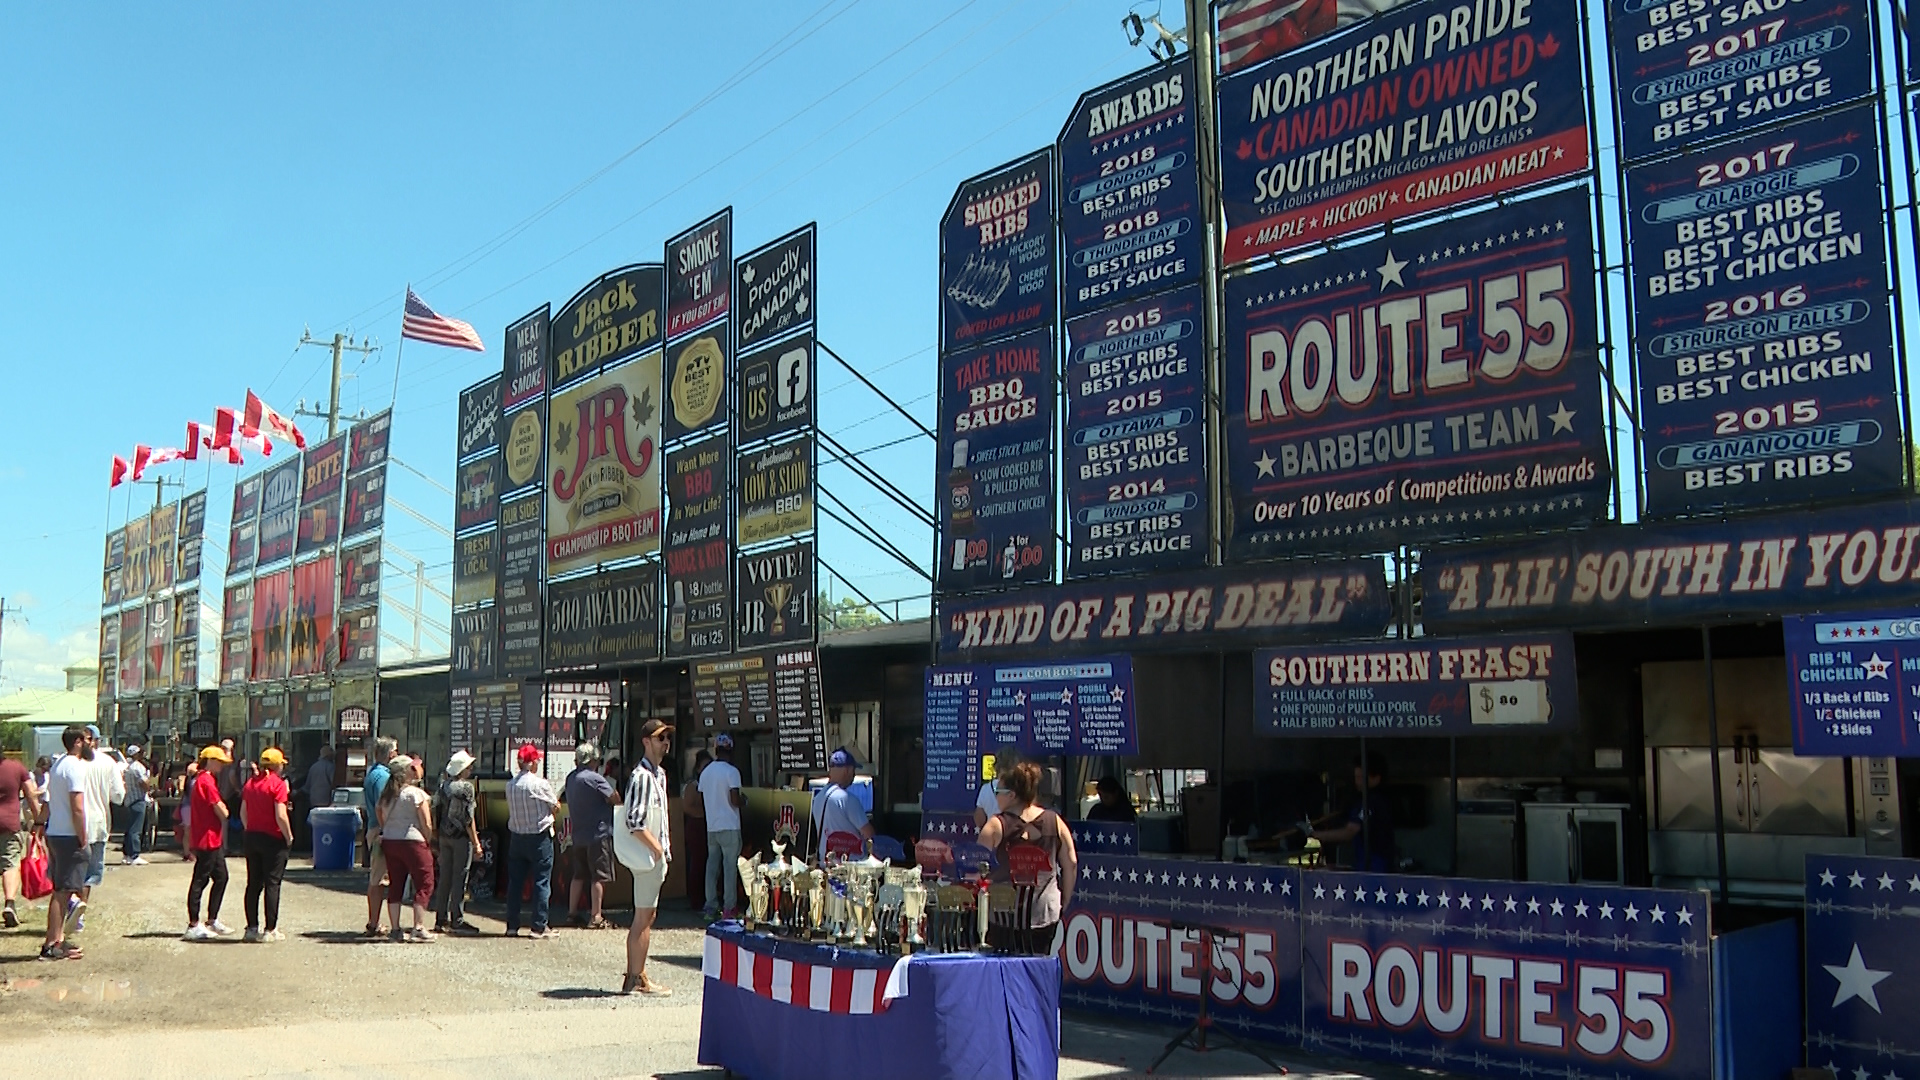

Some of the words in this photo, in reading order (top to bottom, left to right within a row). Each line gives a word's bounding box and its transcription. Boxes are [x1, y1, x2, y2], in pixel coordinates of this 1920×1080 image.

[1637, 13, 1712, 52] BEST
[1686, 20, 1786, 67] 2017
[1249, 22, 1416, 123] NORTHERN
[1425, 0, 1531, 67] PRIDE
[1654, 56, 1761, 96] STRURGEON
[1770, 34, 1826, 63] FALLS
[1088, 74, 1184, 137] AWARDS
[1255, 76, 1401, 161] CANADIAN
[1408, 34, 1535, 108] OWNED
[1660, 83, 1736, 119] BEST
[1746, 58, 1822, 88] RIBS
[1653, 108, 1729, 142] BEST
[1736, 78, 1832, 119] SAUCE
[1253, 126, 1394, 203] SOUTHERN
[1402, 81, 1538, 157] FLAVORS
[1096, 164, 1156, 191] LONDON
[1100, 146, 1156, 177] 2018
[1283, 191, 1313, 211] LOUIS
[1320, 175, 1370, 199] MEMPHIS
[1377, 155, 1428, 181] CHICAGO
[1437, 145, 1467, 164] NEW
[1469, 129, 1525, 156] ORLEANS
[1696, 142, 1796, 187] 2017
[964, 180, 1041, 227] SMOKED
[1083, 190, 1126, 215] BEST
[1130, 174, 1171, 198] RIBS
[1255, 218, 1306, 246] MAPLE
[1322, 191, 1390, 228] HICKORY
[1404, 160, 1496, 203] CANADIAN
[1500, 147, 1551, 177] MEAT
[1696, 173, 1798, 210] CALABOGIE
[980, 209, 1028, 245] RIBS
[1104, 212, 1159, 240] 2018
[1676, 209, 1748, 243] BEST
[1755, 190, 1824, 226] RIBS
[679, 229, 719, 275] SMOKE
[1009, 234, 1046, 257] HICKORY
[1018, 247, 1045, 264] WOOD
[1664, 238, 1734, 270] BEST
[1742, 211, 1842, 253] SAUCE
[749, 246, 799, 309] Proudly
[1018, 265, 1049, 284] CHERRY
[1079, 280, 1122, 302] BEST
[1126, 259, 1185, 289] SAUCE
[1649, 266, 1718, 297] BEST
[1725, 232, 1863, 280] CHICKEN
[743, 262, 809, 340] CANADIAN
[1018, 280, 1044, 295] WOOD
[1704, 285, 1807, 322] 2016
[573, 279, 637, 339] Jack
[1106, 308, 1161, 336] 2015
[517, 322, 539, 349] MEAT
[557, 309, 657, 381] RIBBER
[1246, 283, 1471, 424] ROUTE
[1479, 262, 1570, 380] 55
[1670, 317, 1779, 350] STRURGEON
[1788, 306, 1844, 330] FALLS
[520, 346, 538, 372] FIRE
[955, 354, 990, 392] TAKE
[995, 347, 1040, 375] HOME
[511, 368, 542, 397] SMOKE
[748, 372, 768, 388] FOLLOW
[970, 378, 1023, 407] BBQ
[1656, 376, 1732, 404] BEST
[1740, 352, 1872, 390] CHICKEN
[749, 388, 767, 420] US
[777, 404, 807, 422] facebook
[956, 397, 1036, 432] SAUCE
[1107, 390, 1163, 415] 2015
[1715, 400, 1819, 434] 2015
[1087, 439, 1130, 461] BEST
[1135, 431, 1178, 452] RIBS
[1100, 416, 1164, 439] OTTAWA
[1282, 420, 1434, 477] BARBEQUE
[1445, 404, 1539, 452] TEAM
[1692, 428, 1840, 460] GANANOQUE
[306, 450, 342, 489] BITE
[685, 469, 712, 498] BBQ
[744, 471, 766, 504] LOW
[779, 460, 807, 494] SLOW
[980, 467, 999, 482] SLOW
[1000, 463, 1028, 478] COOKED
[1030, 459, 1043, 471] RIB
[991, 478, 1018, 494] PULLED
[1020, 474, 1040, 490] PORK
[1685, 462, 1765, 490] BEST
[1774, 451, 1853, 480] RIBS
[981, 500, 1016, 518] SOUTHERN
[1017, 495, 1046, 511] CHICKEN
[1109, 478, 1165, 502] 2014
[1254, 499, 1296, 523] Over
[1300, 494, 1321, 516] 10
[1325, 486, 1371, 512] Years
[1375, 481, 1394, 504] of
[1400, 470, 1511, 503] Competitions
[1531, 458, 1595, 487] Awards
[503, 507, 517, 524] OUR
[519, 500, 539, 518] SIDES
[1103, 500, 1167, 518] WINDSOR
[464, 536, 490, 556] FRESH
[554, 528, 609, 558] CHAMPIONSHIP
[612, 524, 631, 542] BBQ
[633, 516, 654, 536] TEAM
[1082, 543, 1126, 562] BEST
[1130, 535, 1191, 554] SAUCE
[464, 558, 488, 576] LOCAL
[747, 552, 804, 585] VOTE!
[1572, 544, 1729, 602] SOUTH
[1732, 538, 1796, 591] IN
[552, 596, 580, 634] 500
[582, 582, 654, 629] AWARDS!
[742, 600, 764, 635] JR
[790, 590, 809, 626] #1
[1050, 596, 1104, 642] OF
[1102, 596, 1134, 638] A
[1140, 587, 1214, 633] PIG
[777, 651, 813, 665] MENU
[1270, 652, 1430, 686] SOUTHERN
[1439, 645, 1552, 680] FEAST
[1800, 667, 1864, 682] CHICKEN
[933, 672, 972, 686] MENU
[1078, 684, 1106, 694] DOUBLE
[1281, 690, 1304, 701] FULL
[1308, 689, 1334, 700] RACK
[1336, 690, 1346, 700] of
[1349, 688, 1374, 700] RIBS
[1804, 692, 1821, 704] 1/3
[1824, 692, 1851, 703] Rack
[1853, 692, 1861, 701] of
[1864, 691, 1889, 702] Ribs
[1281, 703, 1300, 715] ONE
[1302, 703, 1335, 714] POUND
[1337, 702, 1347, 713] of
[1348, 702, 1385, 714] PULLED
[1388, 702, 1416, 713] PORK
[1281, 718, 1307, 728] HALF
[1310, 717, 1335, 728] BIRD
[1348, 716, 1368, 727] Plus
[1370, 716, 1393, 728] ANY
[1407, 715, 1442, 726] SIDES
[1209, 931, 1275, 1005] 55
[1331, 941, 1563, 1047] ROUTE
[1576, 966, 1671, 1062] 55
